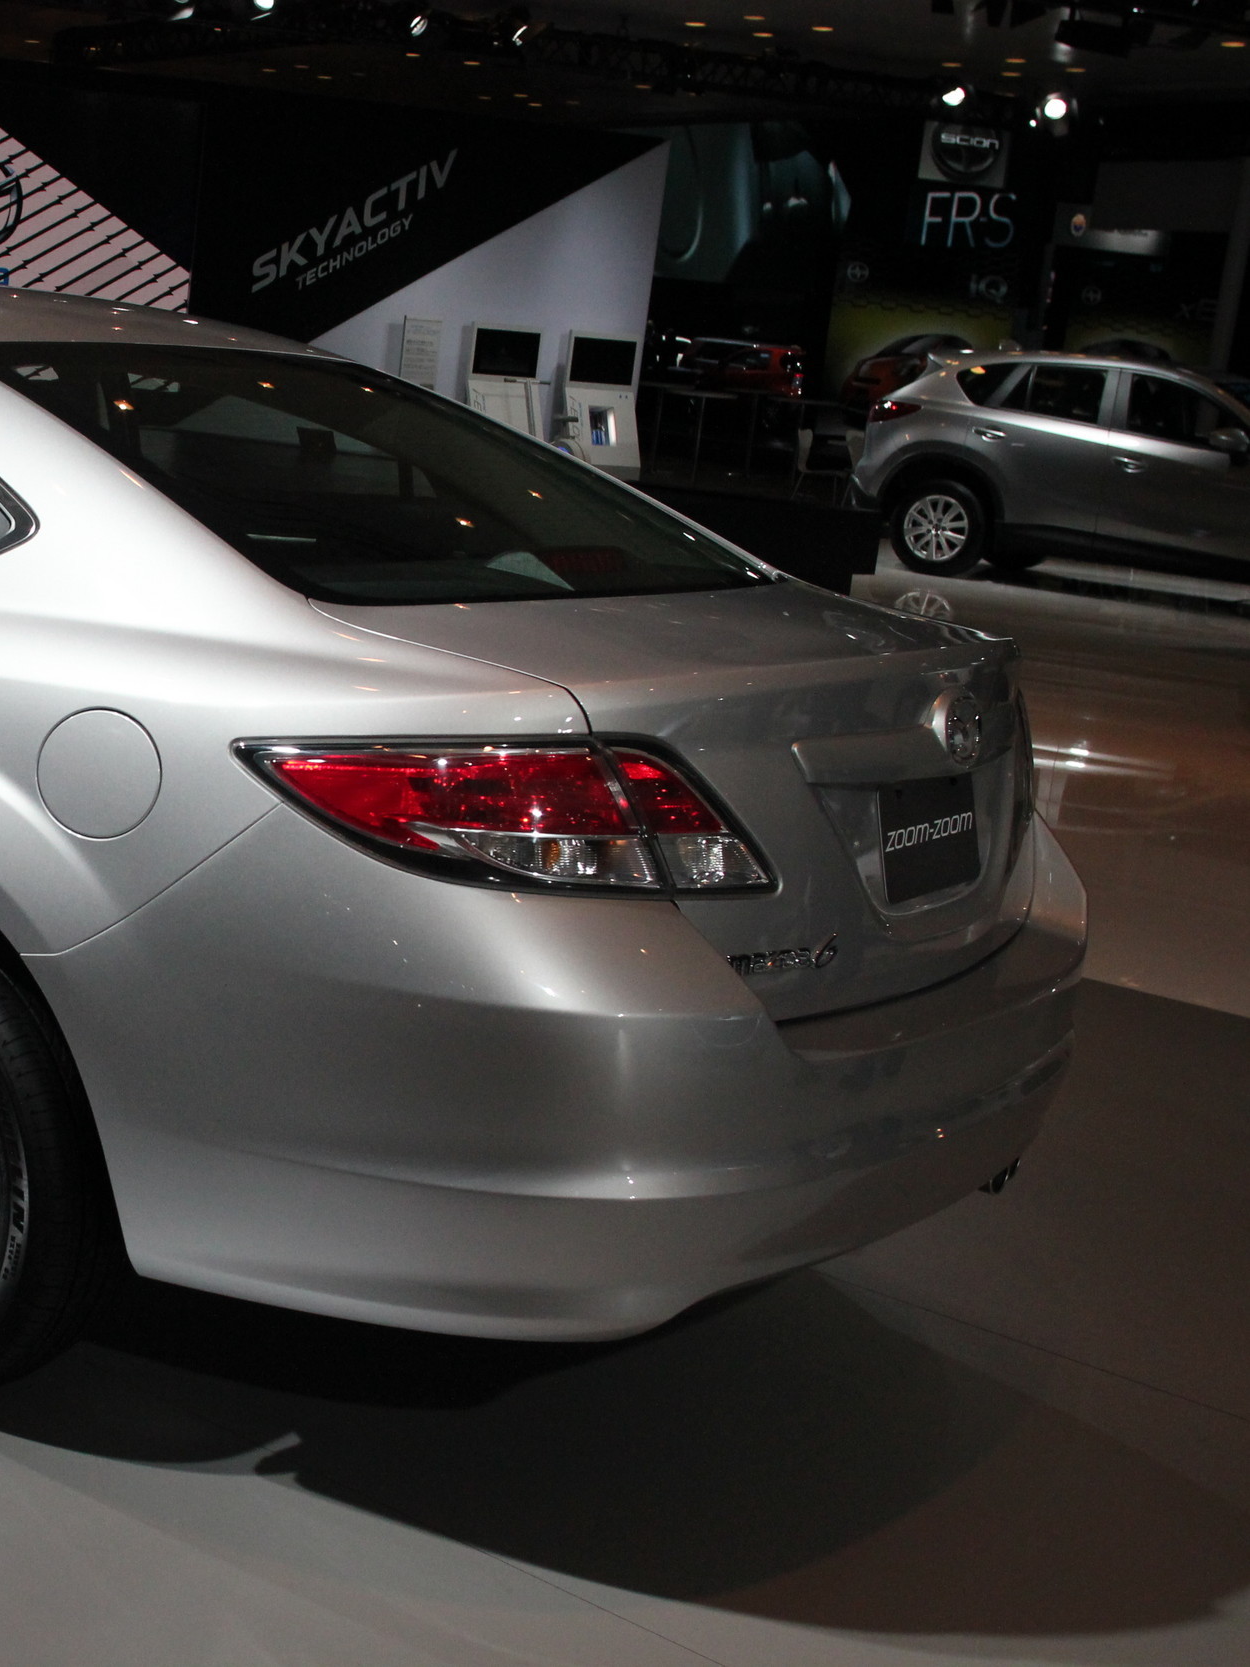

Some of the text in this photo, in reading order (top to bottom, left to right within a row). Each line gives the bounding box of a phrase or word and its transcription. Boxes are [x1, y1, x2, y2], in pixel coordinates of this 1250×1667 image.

[251, 148, 459, 294] SKYACTIV
[295, 213, 414, 291] TECHNOLOGY
[920, 191, 1017, 248] FR-S
[884, 811, 973, 853] zoom-zoom
